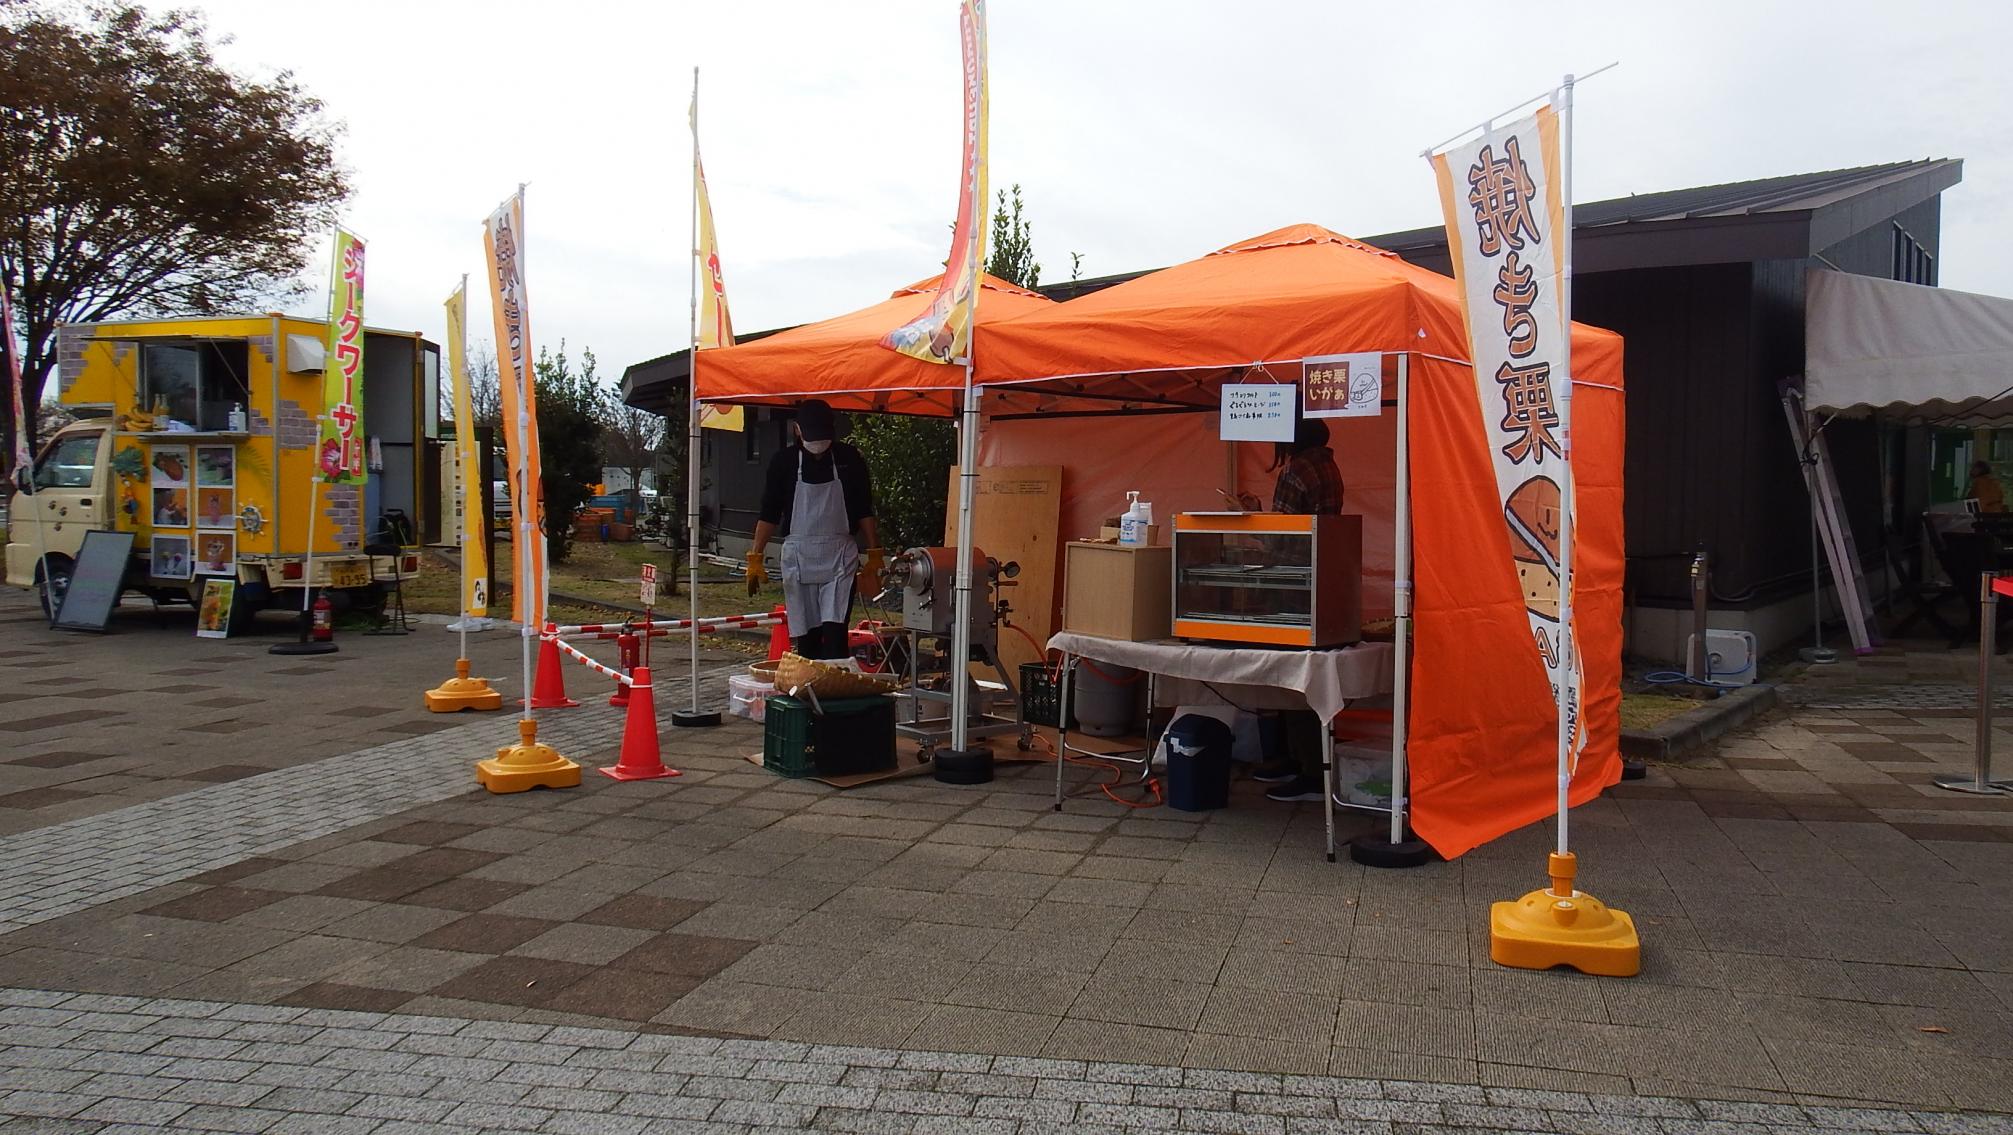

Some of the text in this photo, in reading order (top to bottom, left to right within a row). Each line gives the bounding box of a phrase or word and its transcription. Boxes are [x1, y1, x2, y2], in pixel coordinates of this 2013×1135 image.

[332, 247, 361, 471] シークワーサー
[1309, 368, 1347, 384] 焼き栗
